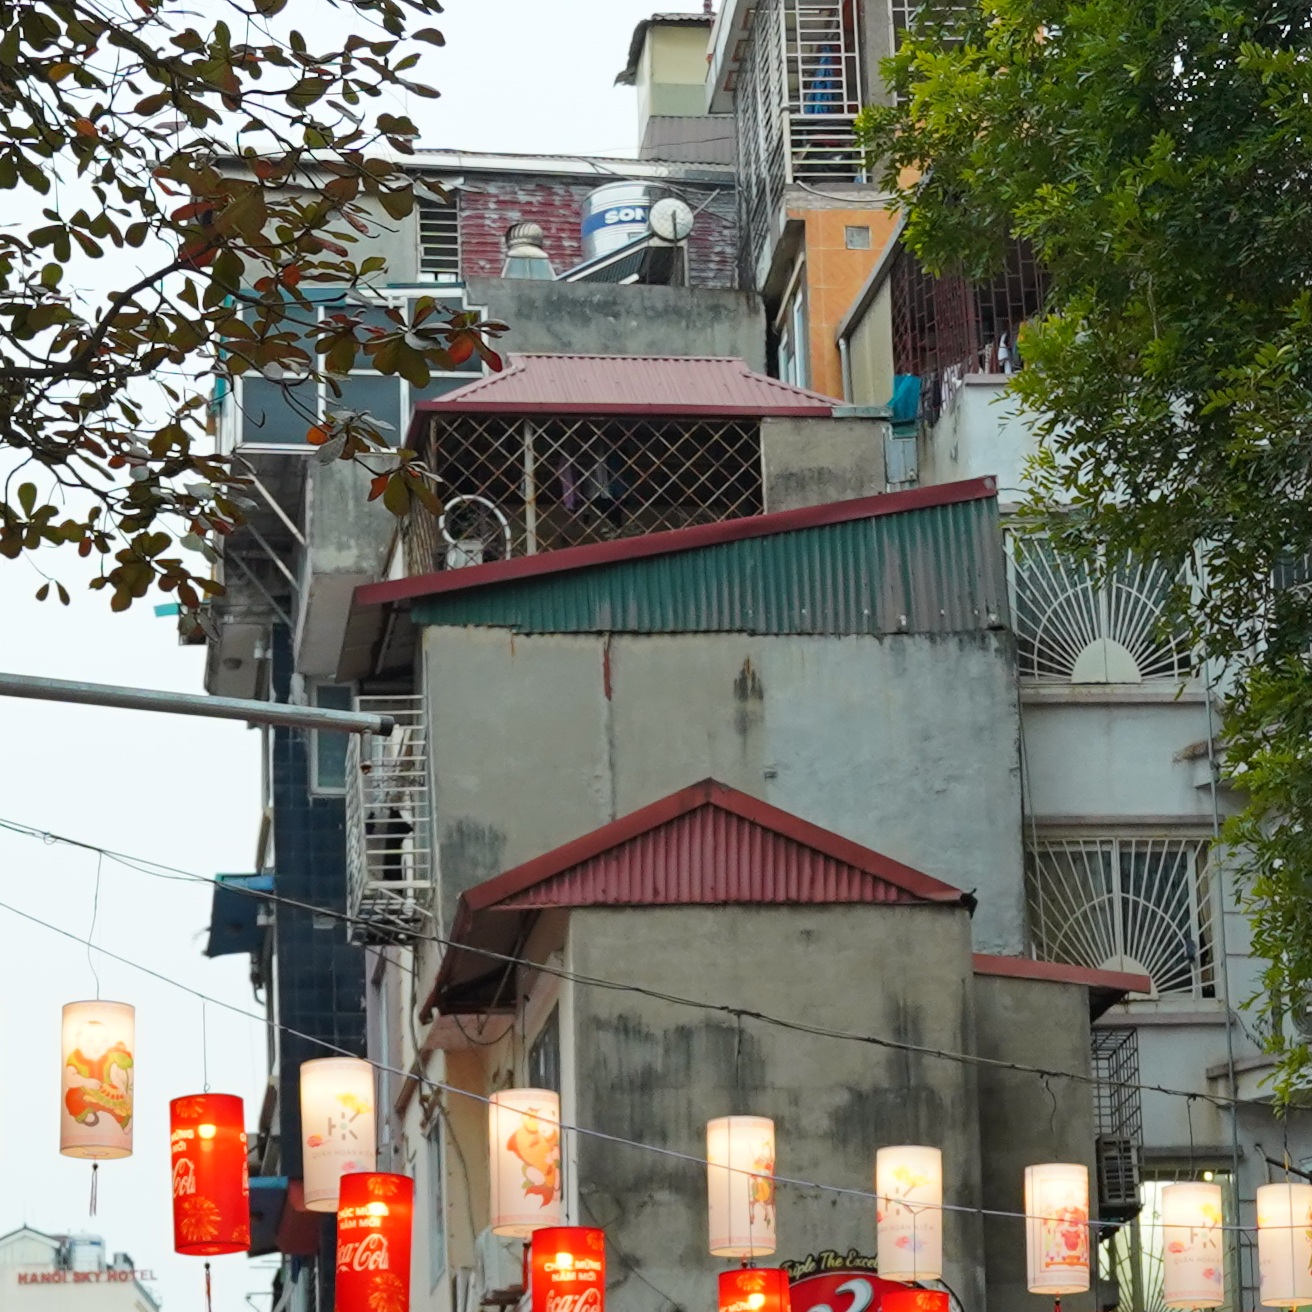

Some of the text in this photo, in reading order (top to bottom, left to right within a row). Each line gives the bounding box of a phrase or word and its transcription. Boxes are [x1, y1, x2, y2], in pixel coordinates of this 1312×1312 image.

[820, 1249, 844, 1270] The
[73, 1269, 101, 1284] SKY
[107, 1269, 158, 1283] HOTEL
